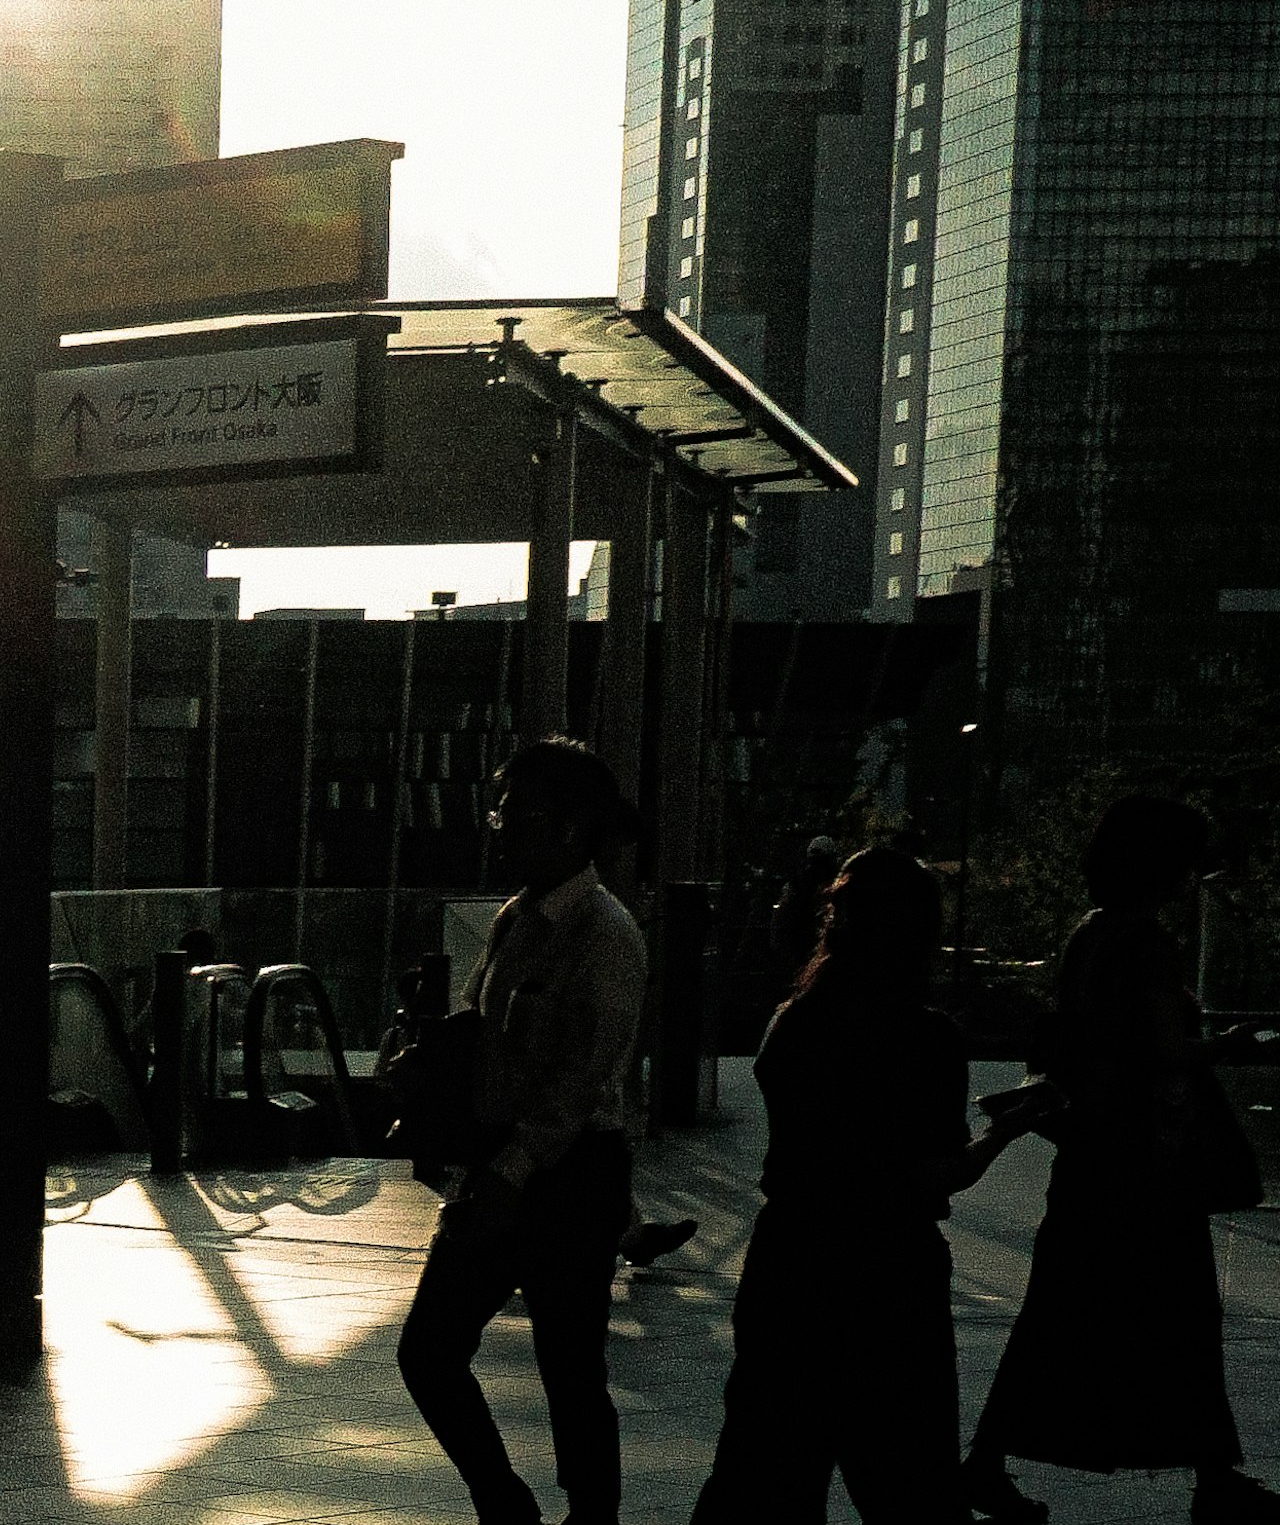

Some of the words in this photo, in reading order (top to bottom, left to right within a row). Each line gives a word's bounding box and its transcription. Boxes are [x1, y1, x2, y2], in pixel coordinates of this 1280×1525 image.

[114, 371, 323, 423] グランフロント大阪
[112, 430, 166, 452] Grand
[171, 425, 217, 446] Front
[223, 420, 277, 442] Osaka
